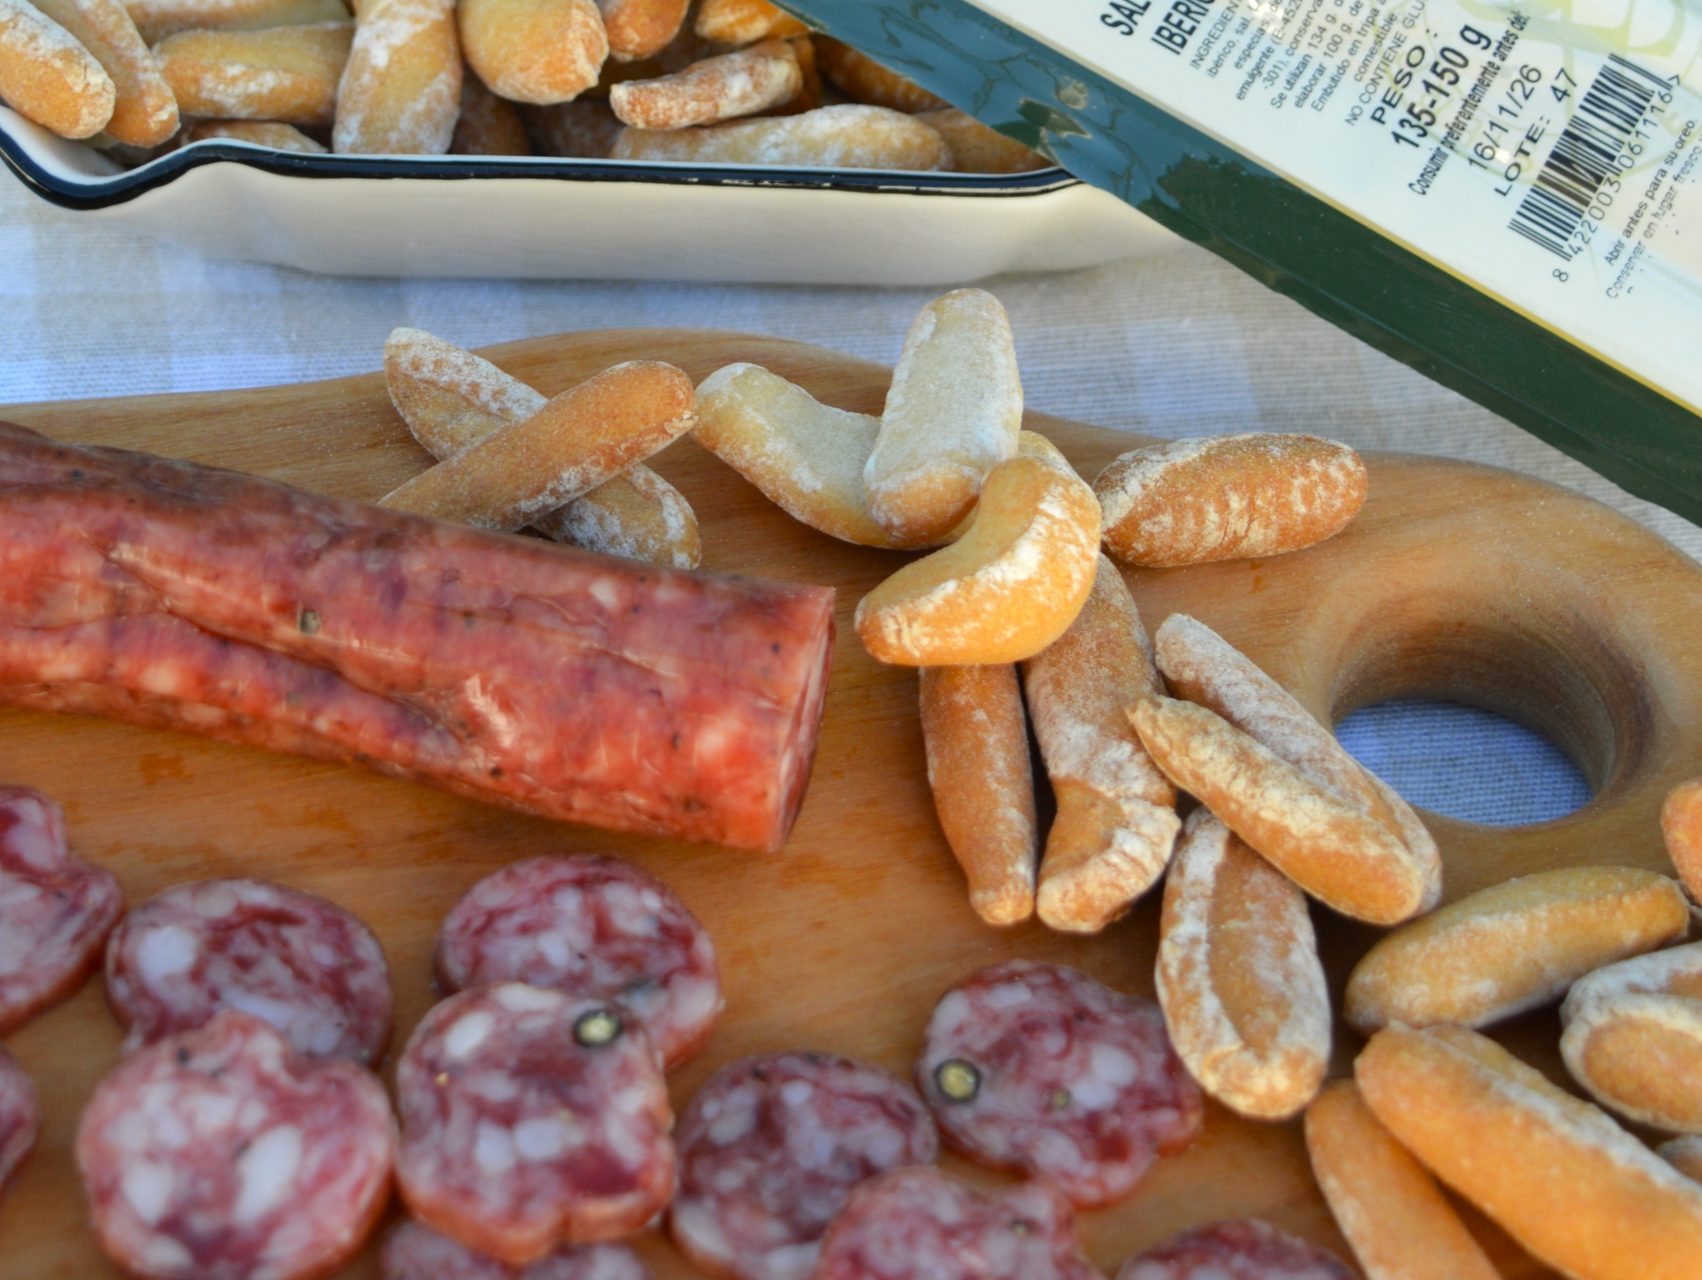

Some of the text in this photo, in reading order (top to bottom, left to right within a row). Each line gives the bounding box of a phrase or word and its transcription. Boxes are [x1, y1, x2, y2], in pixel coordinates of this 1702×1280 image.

[1235, 44, 1275, 101] emulgente
[1270, 91, 1287, 109] Se
[1282, 52, 1312, 92] utilizan
[1307, 24, 1327, 49] 134
[1293, 61, 1327, 109] elaborar
[1322, 33, 1343, 59] 100
[1310, 57, 1350, 112] Embutido
[1355, 6, 1381, 37] tripa
[1344, 104, 1364, 126] NO
[1357, 30, 1407, 104] CONTIENE
[1370, 43, 1427, 125] PESO
[1389, 23, 1492, 150] 135-150 g
[1407, 144, 1449, 196] Consumir
[1437, 58, 1503, 153] preferentemente
[1490, 28, 1519, 61] antes
[1465, 62, 1542, 172] 16/11/26
[1493, 67, 1578, 197] LOTE: 47
[1603, 238, 1625, 266] Abrir
[1621, 200, 1648, 238] antes
[1643, 167, 1668, 200] para
